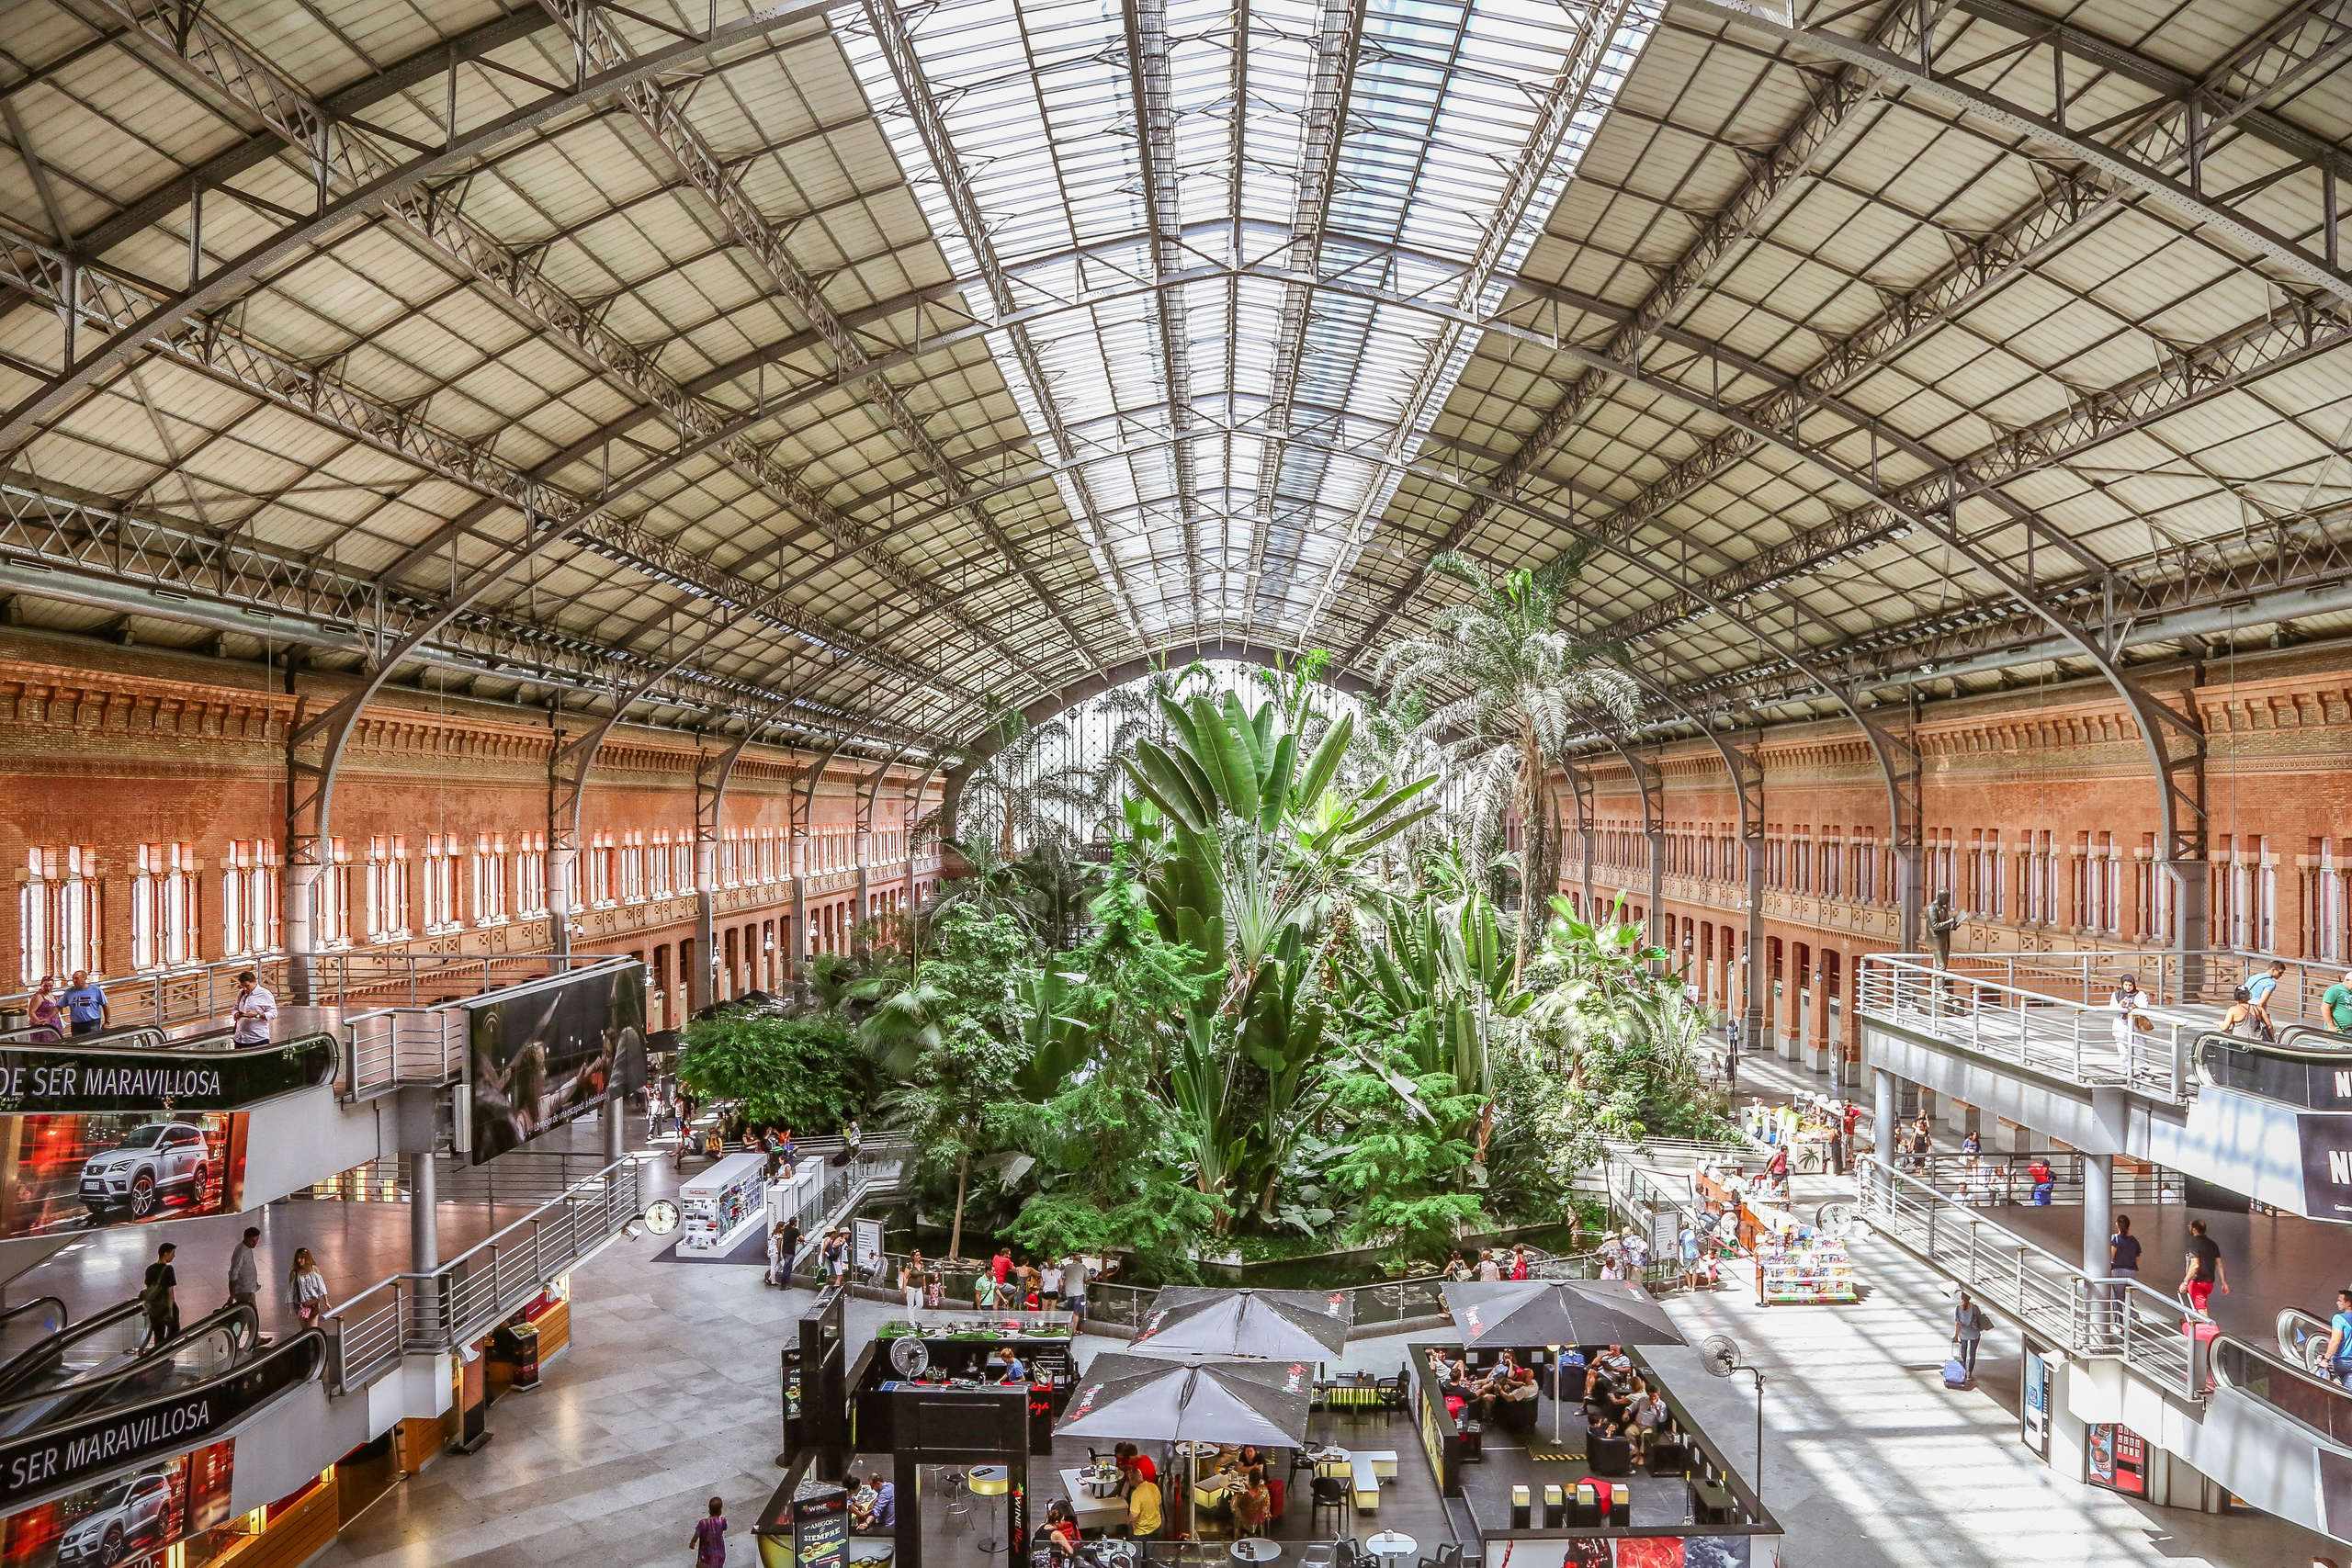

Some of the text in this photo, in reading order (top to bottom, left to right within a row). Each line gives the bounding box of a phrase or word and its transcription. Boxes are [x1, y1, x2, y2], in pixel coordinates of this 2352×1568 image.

[32, 1067, 76, 1096] SER
[84, 1068, 220, 1096] MARAVILLOSA
[9, 1401, 209, 1489] SER MARAVILLOSA
[808, 1503, 827, 1512] WINE
[810, 1519, 833, 1529] AMIGOS
[804, 1527, 841, 1541] SIEMPRE
